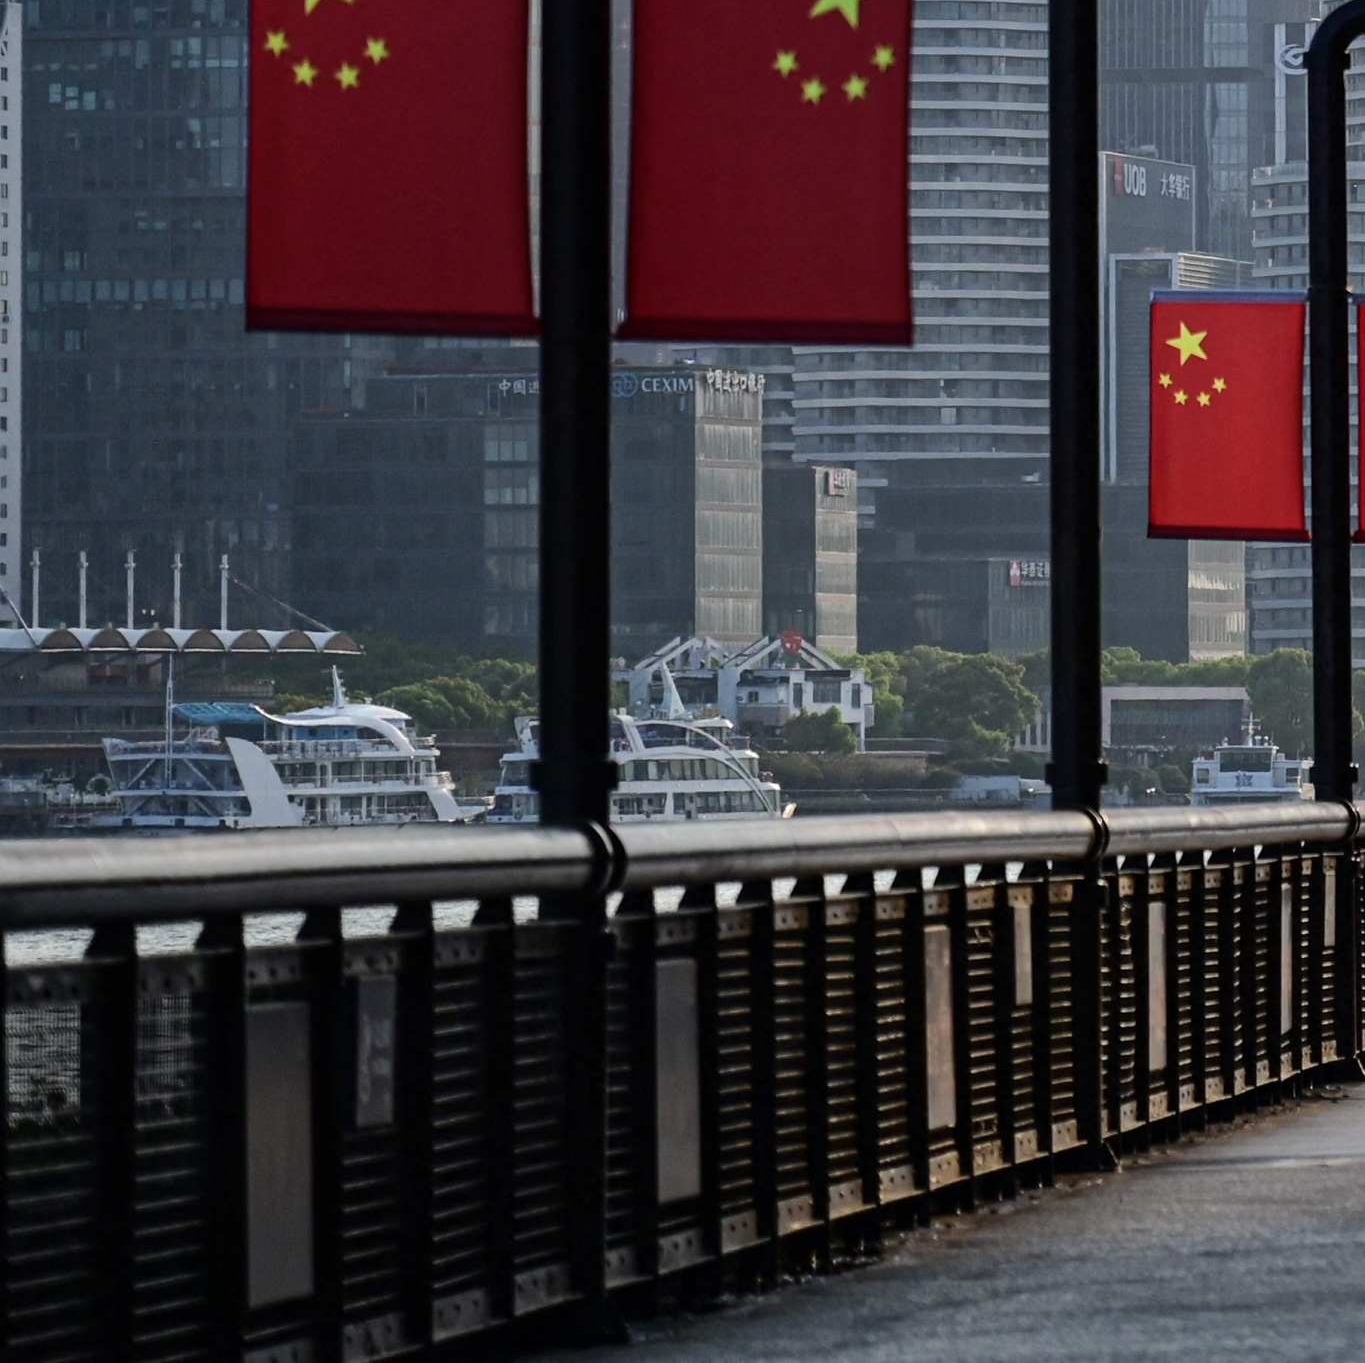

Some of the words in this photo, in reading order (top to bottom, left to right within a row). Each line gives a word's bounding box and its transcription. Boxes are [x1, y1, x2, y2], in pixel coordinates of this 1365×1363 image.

[1124, 163, 1147, 196] UOB
[1160, 173, 1190, 200] 大华银行
[641, 377, 694, 393] CEXIM
[706, 368, 766, 394] 中国进出口银行
